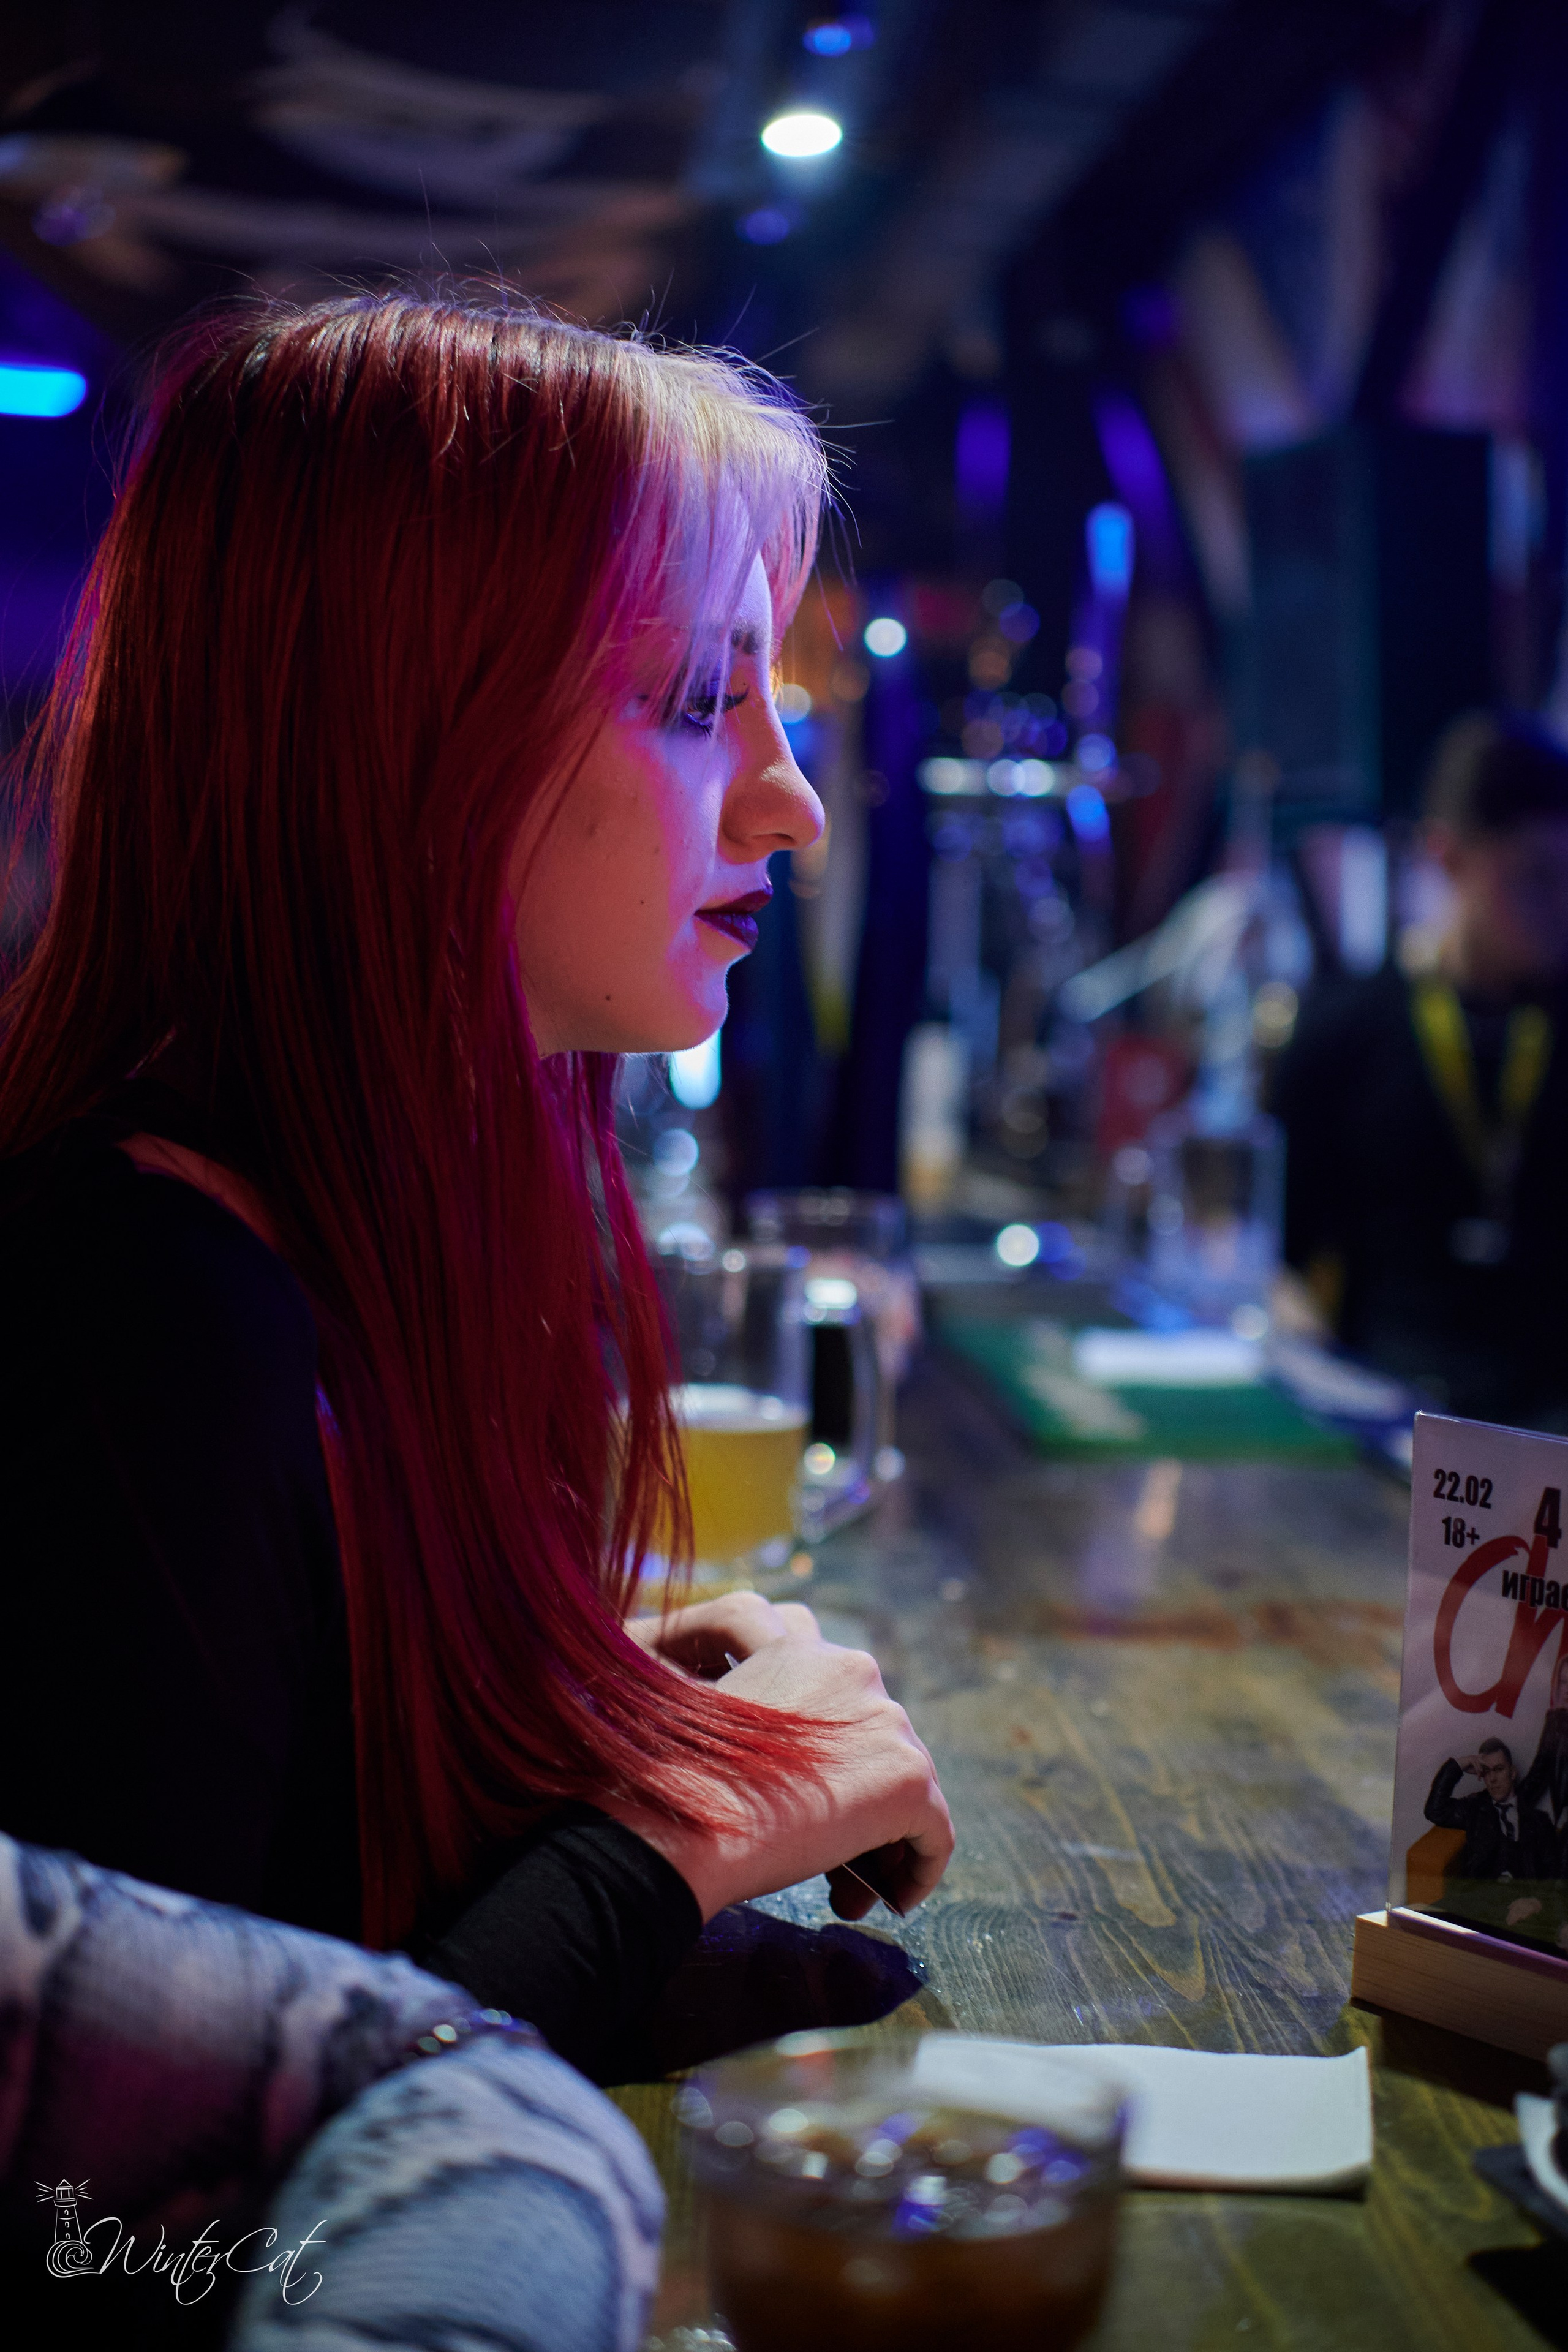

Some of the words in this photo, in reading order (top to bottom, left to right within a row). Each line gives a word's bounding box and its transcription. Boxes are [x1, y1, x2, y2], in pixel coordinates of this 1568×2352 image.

[1433, 1469, 1493, 1509] 22.02
[1442, 1516, 1480, 1548] 18+
[1534, 1487, 1561, 1549] 4
